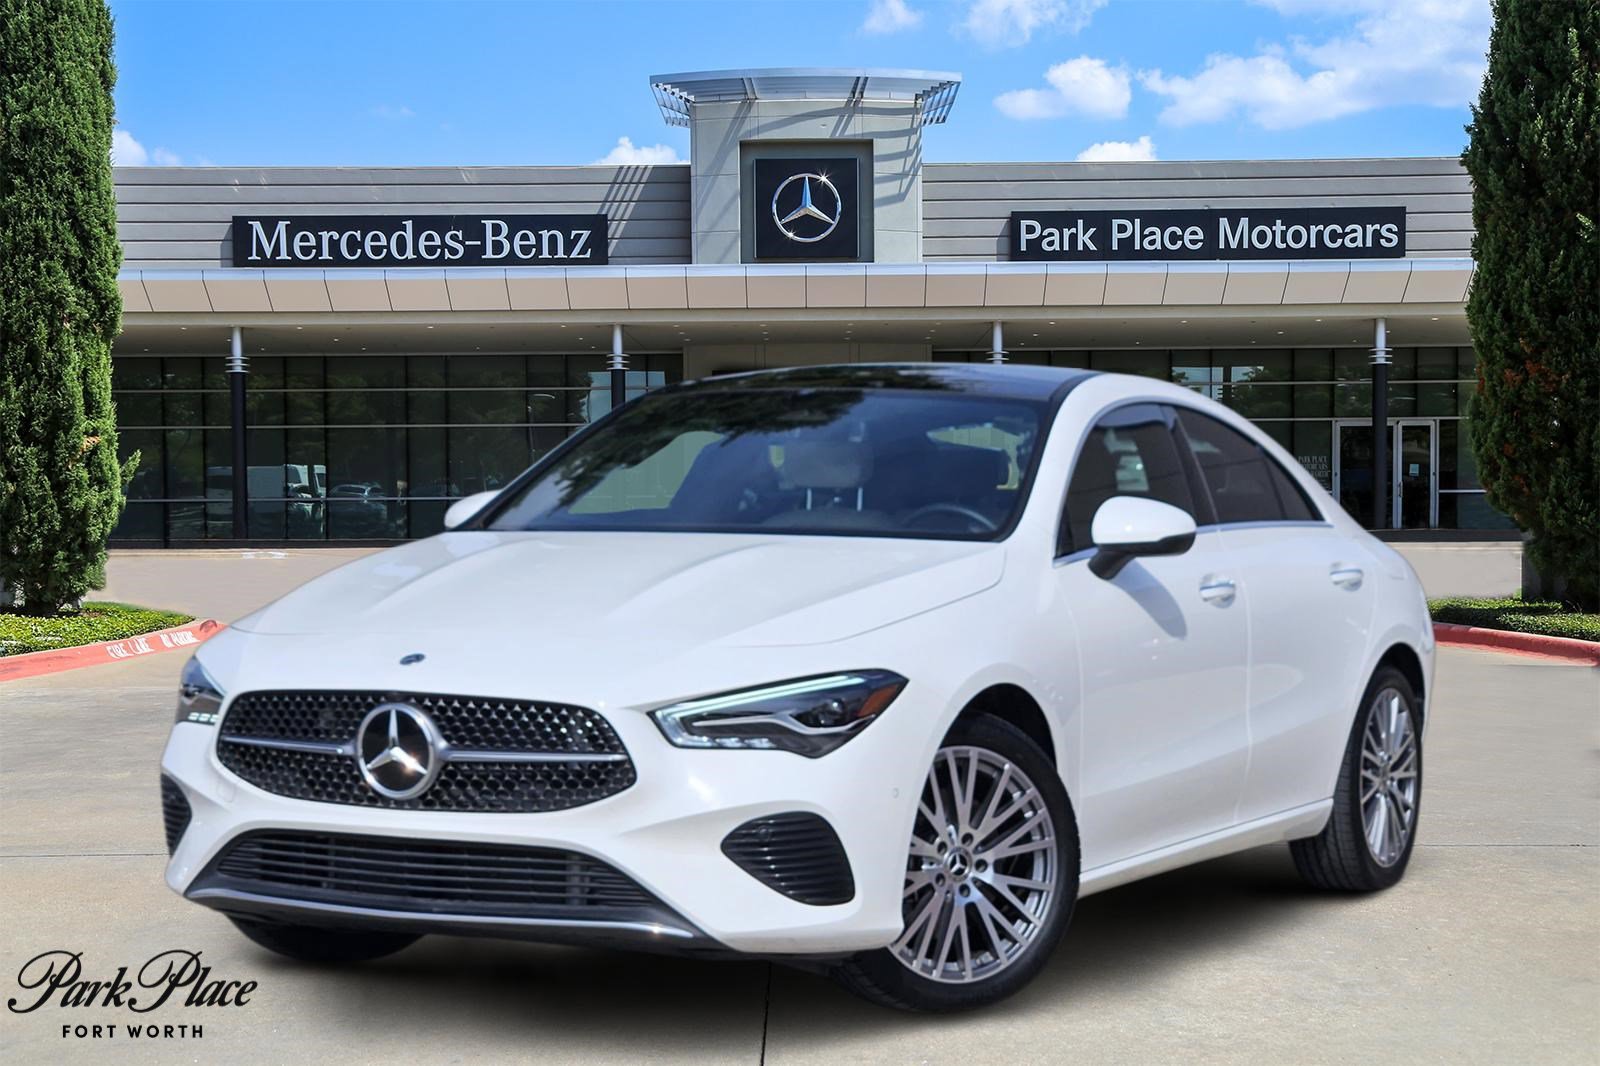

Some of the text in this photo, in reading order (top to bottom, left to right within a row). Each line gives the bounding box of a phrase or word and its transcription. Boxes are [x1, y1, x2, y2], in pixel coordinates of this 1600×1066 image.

[247, 219, 592, 261] Mercedes-Benz
[1019, 216, 1400, 252] Park Place Motorcars
